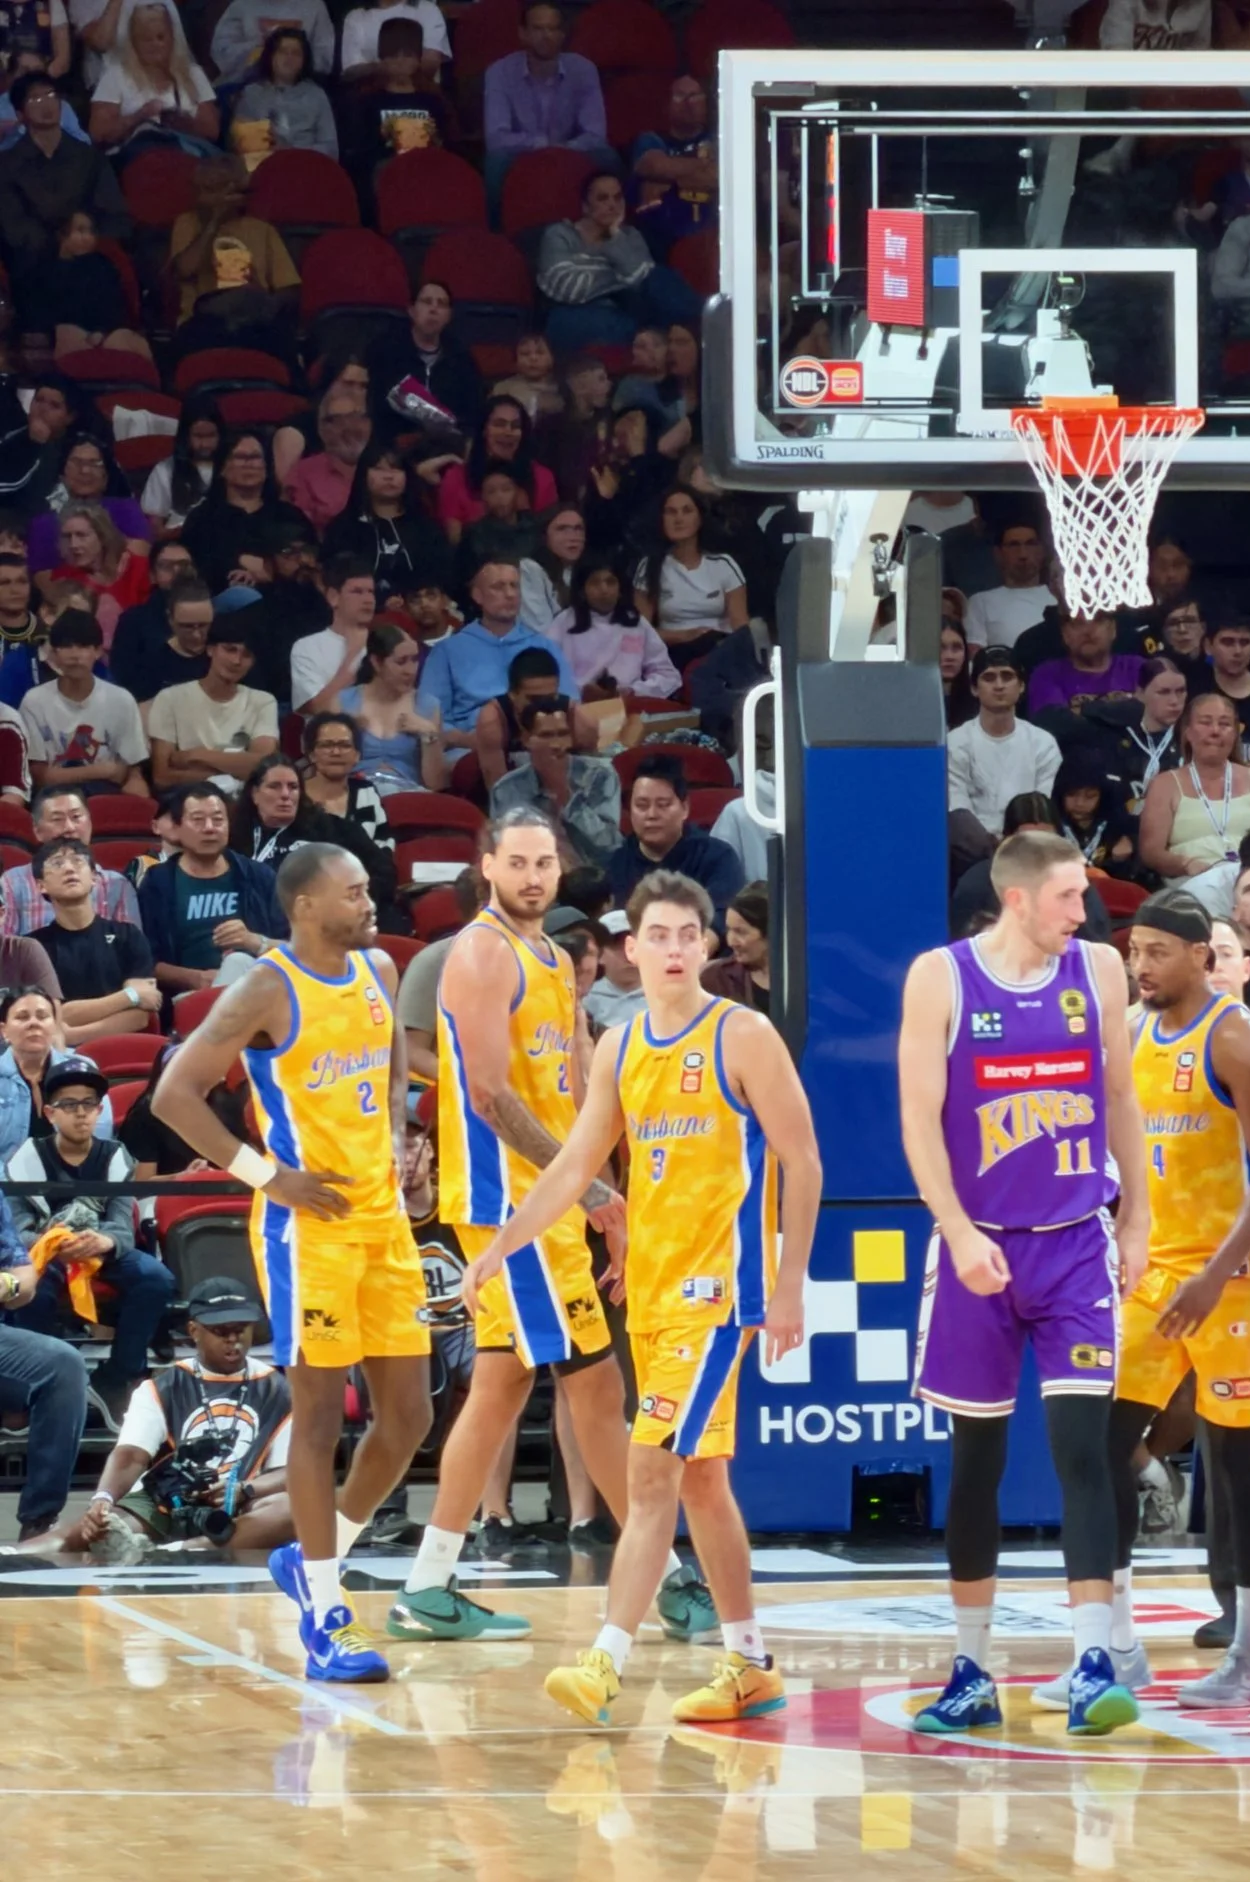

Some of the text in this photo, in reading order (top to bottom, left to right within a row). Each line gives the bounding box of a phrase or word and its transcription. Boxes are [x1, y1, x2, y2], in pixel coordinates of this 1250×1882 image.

[757, 444, 824, 459] SPALDING
[186, 892, 239, 921] NIKE
[357, 1080, 379, 1115] 2
[974, 1089, 1096, 1178] KINGS
[650, 1147, 667, 1183] 3
[1054, 1136, 1097, 1176] 11
[1151, 1143, 1167, 1178] 4
[760, 1403, 954, 1444] HOSTPL
